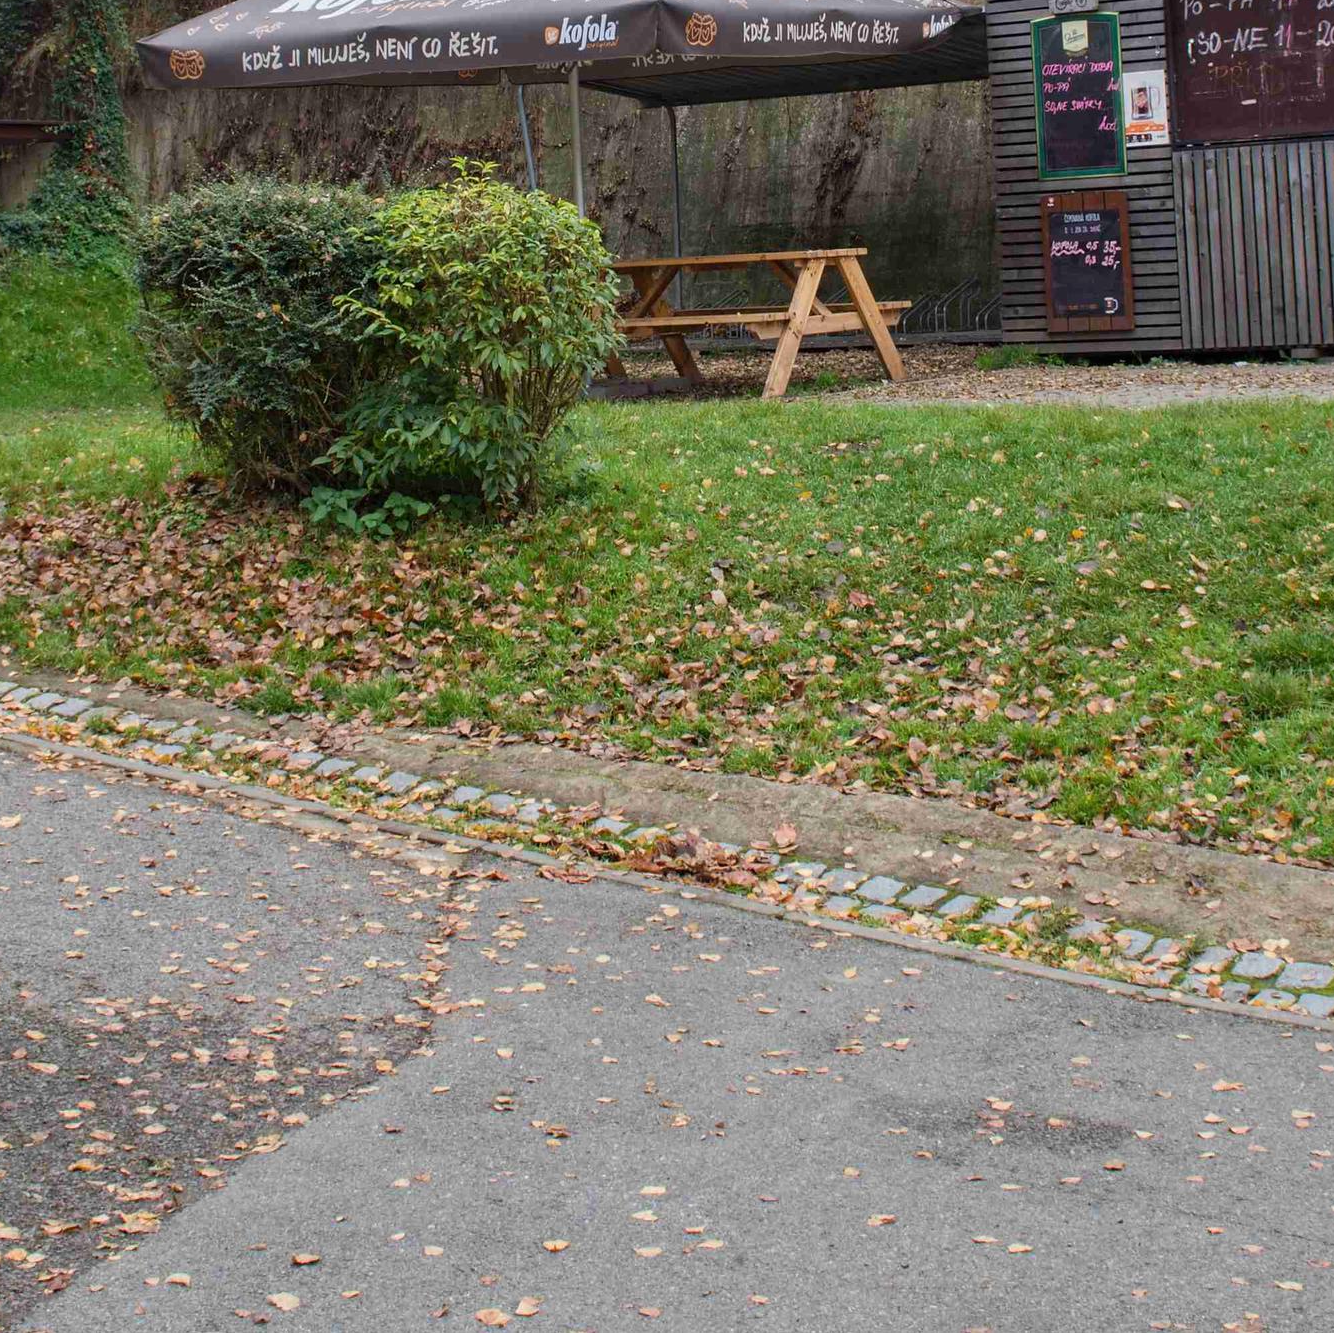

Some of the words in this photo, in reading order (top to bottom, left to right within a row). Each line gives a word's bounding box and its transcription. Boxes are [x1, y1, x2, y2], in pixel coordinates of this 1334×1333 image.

[559, 14, 618, 51] kofola
[743, 16, 771, 43] KDYŽ
[774, 23, 783, 42] JI
[786, 13, 827, 43] MILUJEŠ,
[830, 21, 856, 44] NENÍ
[857, 23, 869, 43] CO
[872, 19, 899, 45] ŘEŠIT.
[242, 45, 283, 72] KDYŽ
[289, 49, 300, 67] JI
[307, 32, 370, 66] MILUJEŠ,
[375, 36, 418, 61] NENÍ
[422, 37, 441, 58] CO
[448, 31, 499, 58] ŘEŠIT.
